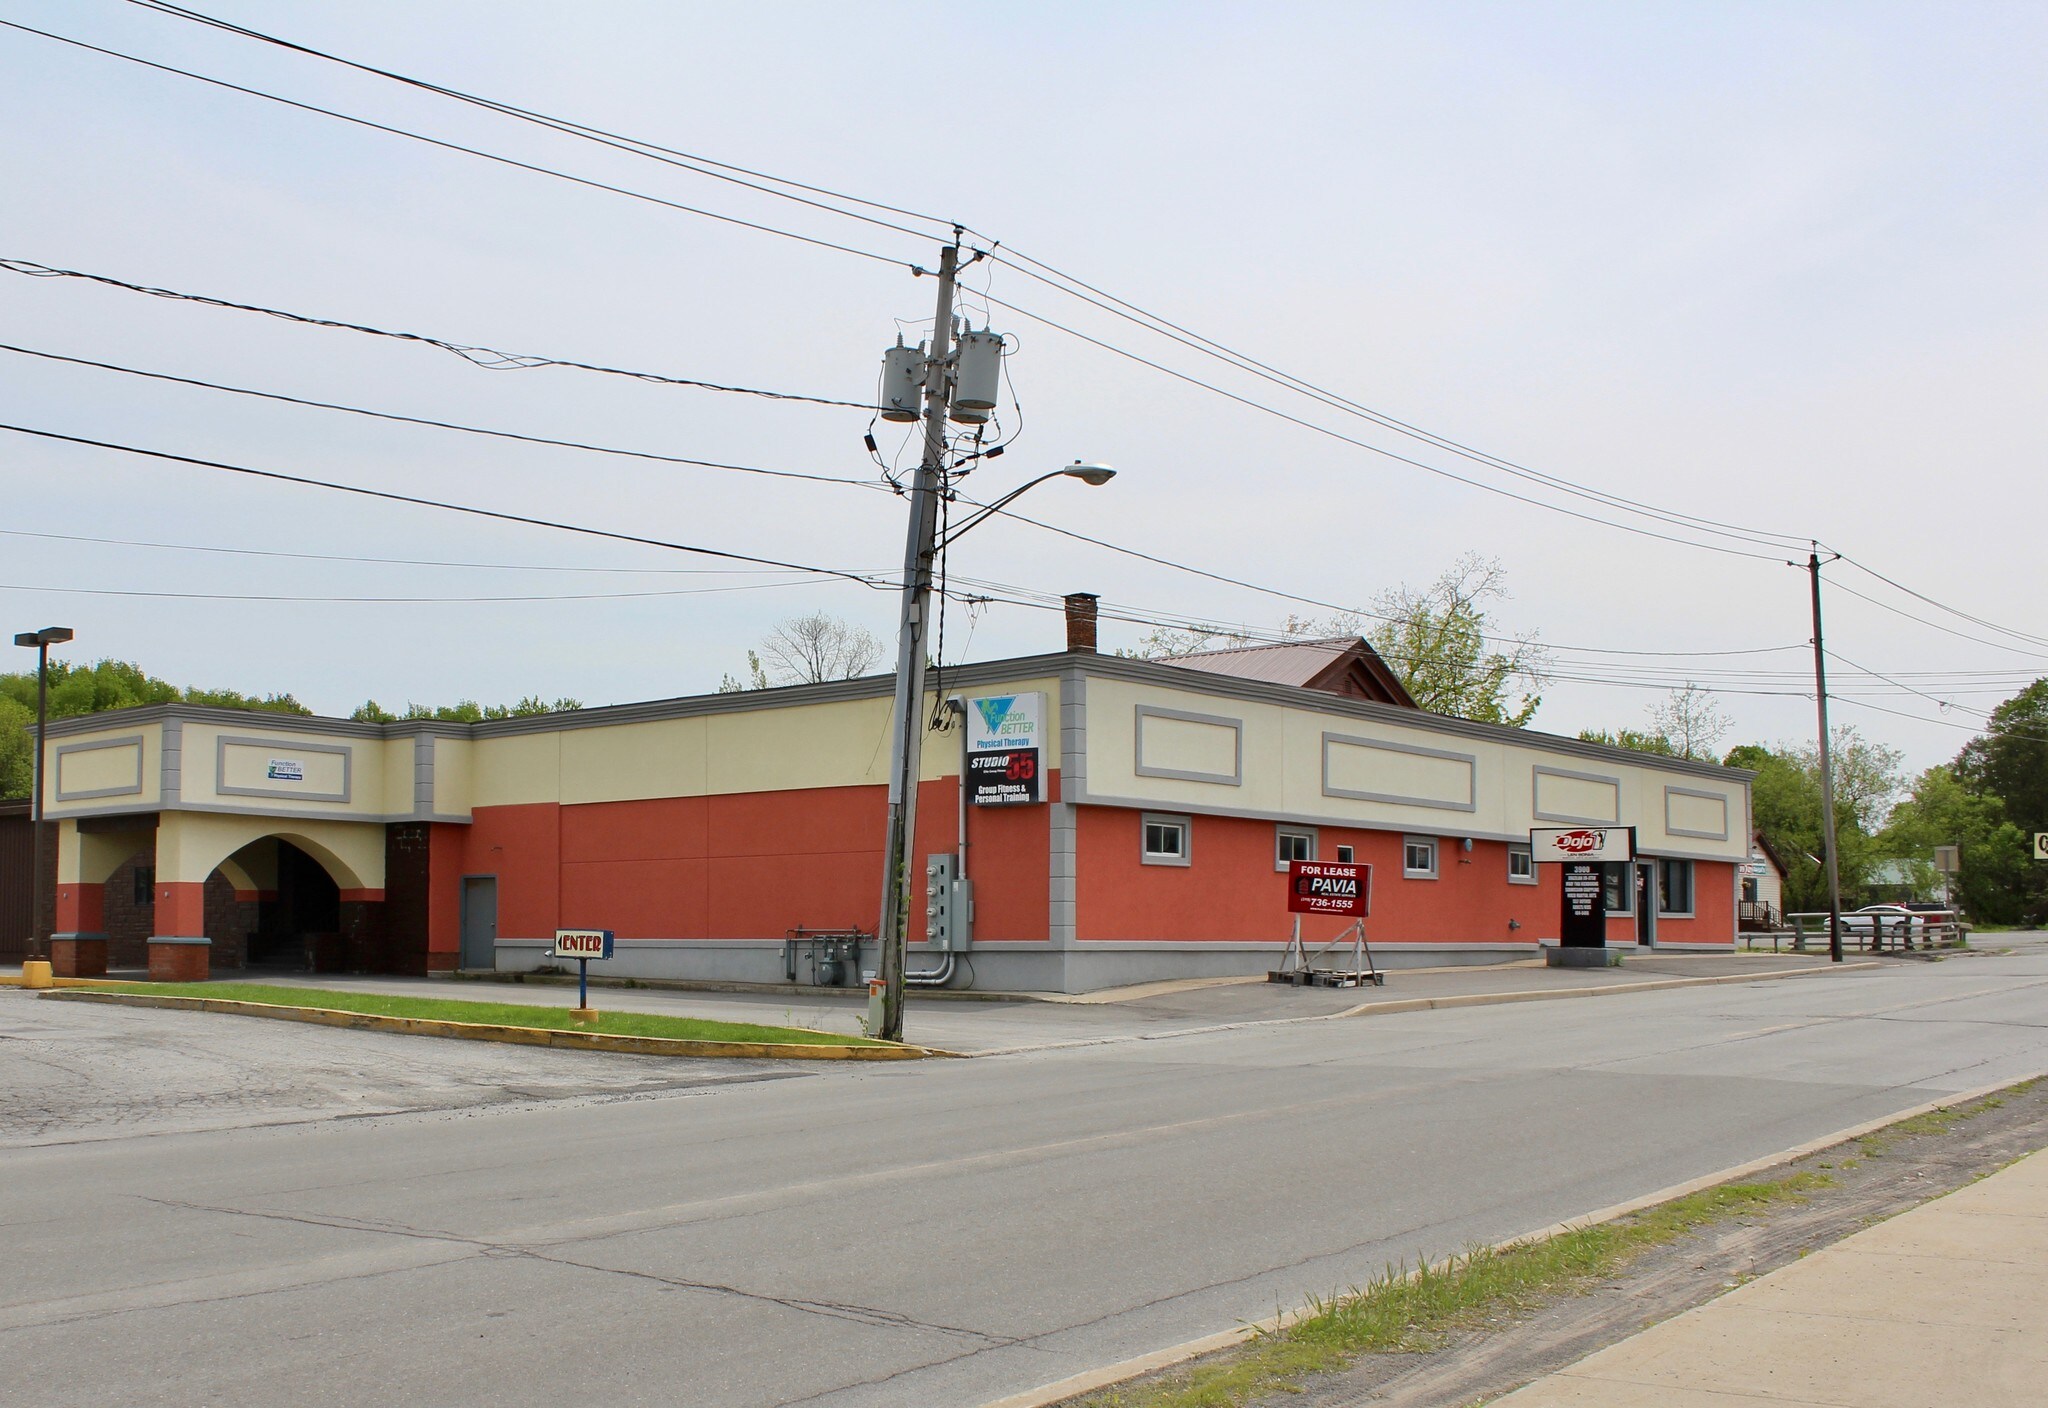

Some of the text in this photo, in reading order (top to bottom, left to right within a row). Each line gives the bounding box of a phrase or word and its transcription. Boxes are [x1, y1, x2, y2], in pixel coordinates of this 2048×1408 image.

[990, 711, 1025, 723] Function
[1001, 721, 1034, 735] BETTER
[977, 737, 1030, 749] Physical Therapy
[971, 752, 1035, 780] STUDIO 55
[978, 784, 1026, 795] Group Fitness &
[975, 792, 1030, 803] Personal Training
[1301, 865, 1357, 877] FOR LEASE
[1311, 877, 1357, 894] PAVIA
[1310, 898, 1354, 909] 736-1555
[562, 934, 602, 951] ENTER
